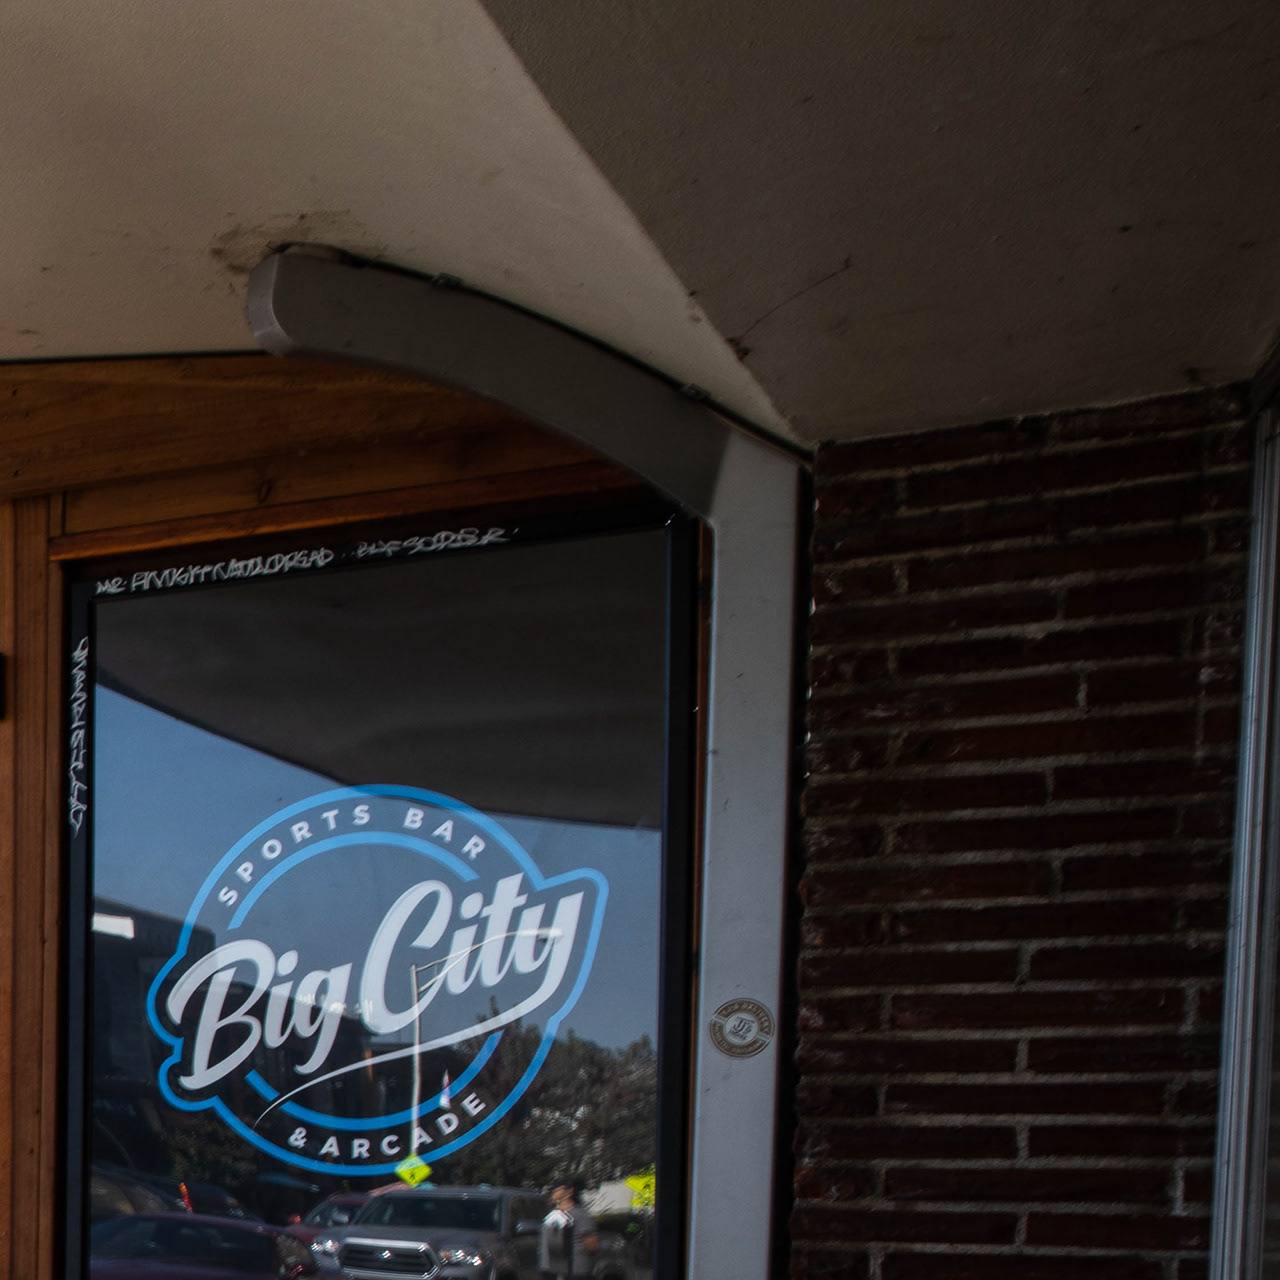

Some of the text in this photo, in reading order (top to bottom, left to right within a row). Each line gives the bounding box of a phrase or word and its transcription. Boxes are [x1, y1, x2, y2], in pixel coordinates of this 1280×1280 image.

[218, 804, 487, 907] SPORTS BAR
[167, 871, 585, 1091] Big City
[287, 1092, 487, 1160] & ARCADE
